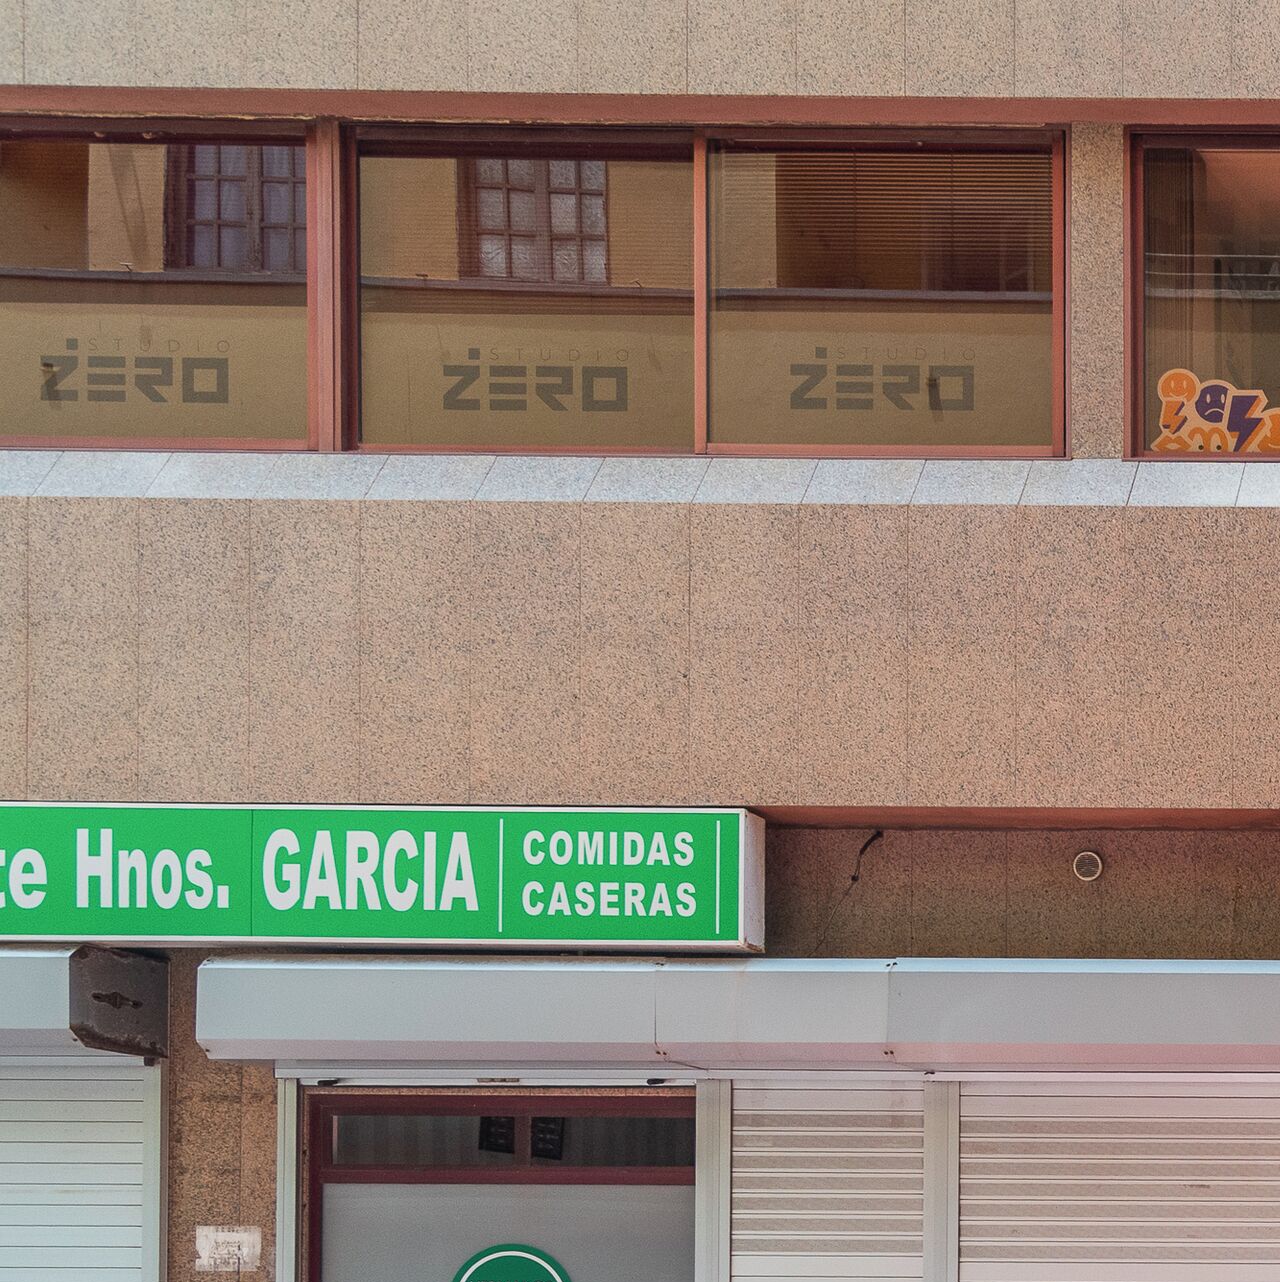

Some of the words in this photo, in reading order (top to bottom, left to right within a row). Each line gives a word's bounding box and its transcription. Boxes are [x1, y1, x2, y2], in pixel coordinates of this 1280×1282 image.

[521, 831, 695, 867] COMIDAS
[0, 848, 48, 909] e
[76, 828, 229, 910] Hnos.
[262, 829, 480, 911] GARCIA
[521, 881, 698, 917] CASERAS
